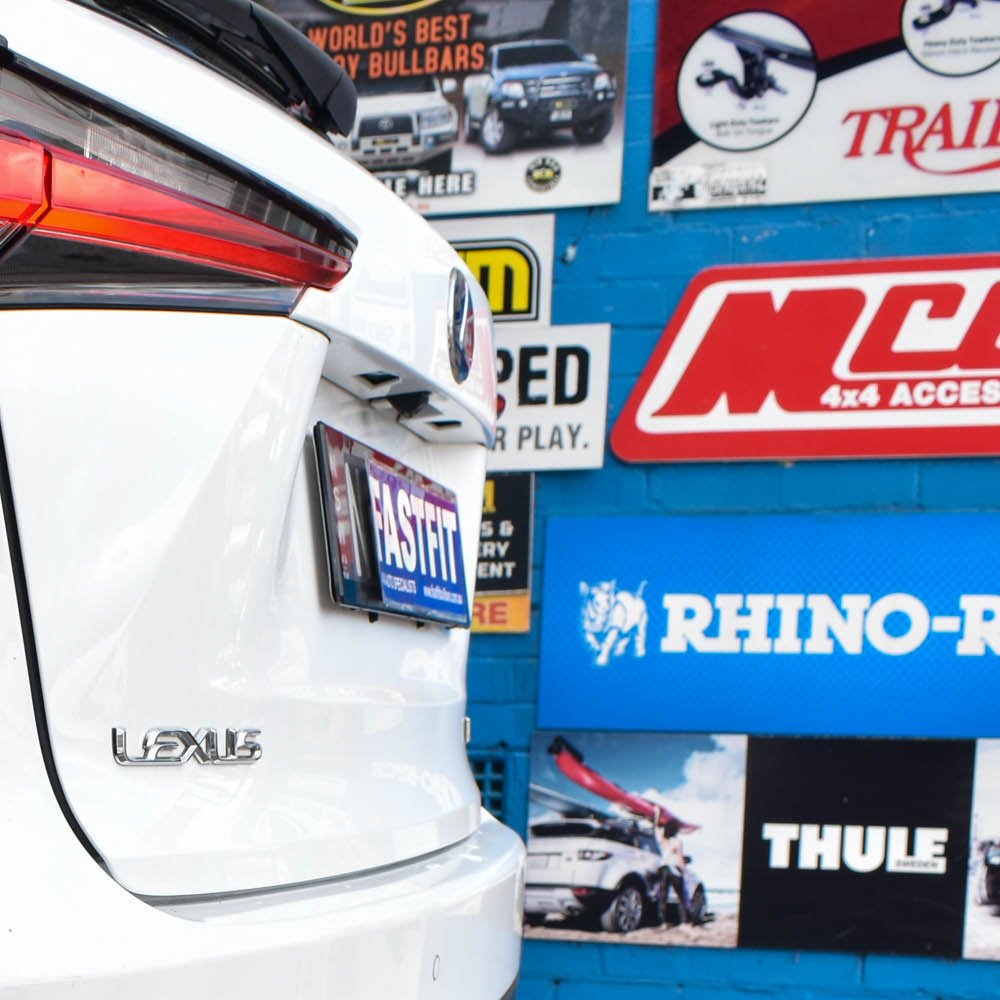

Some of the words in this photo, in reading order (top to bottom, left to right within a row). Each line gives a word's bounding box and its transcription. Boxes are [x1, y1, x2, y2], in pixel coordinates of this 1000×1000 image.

[308, 19, 407, 52] WORLD'S
[415, 13, 472, 44] BEST
[368, 42, 485, 79] BULLBARS
[417, 171, 475, 197] HERE
[820, 383, 880, 408] 4x4
[888, 379, 1000, 407] ACCES
[518, 423, 589, 450] PLAY.
[369, 475, 458, 584] FASTFIT
[499, 520, 514, 537] &
[478, 541, 510, 559] RY
[477, 562, 516, 579] ENT
[472, 602, 508, 624] RE
[661, 593, 1000, 656] RHINO-R
[111, 727, 263, 766] LEXUS
[762, 823, 949, 874] THULE
